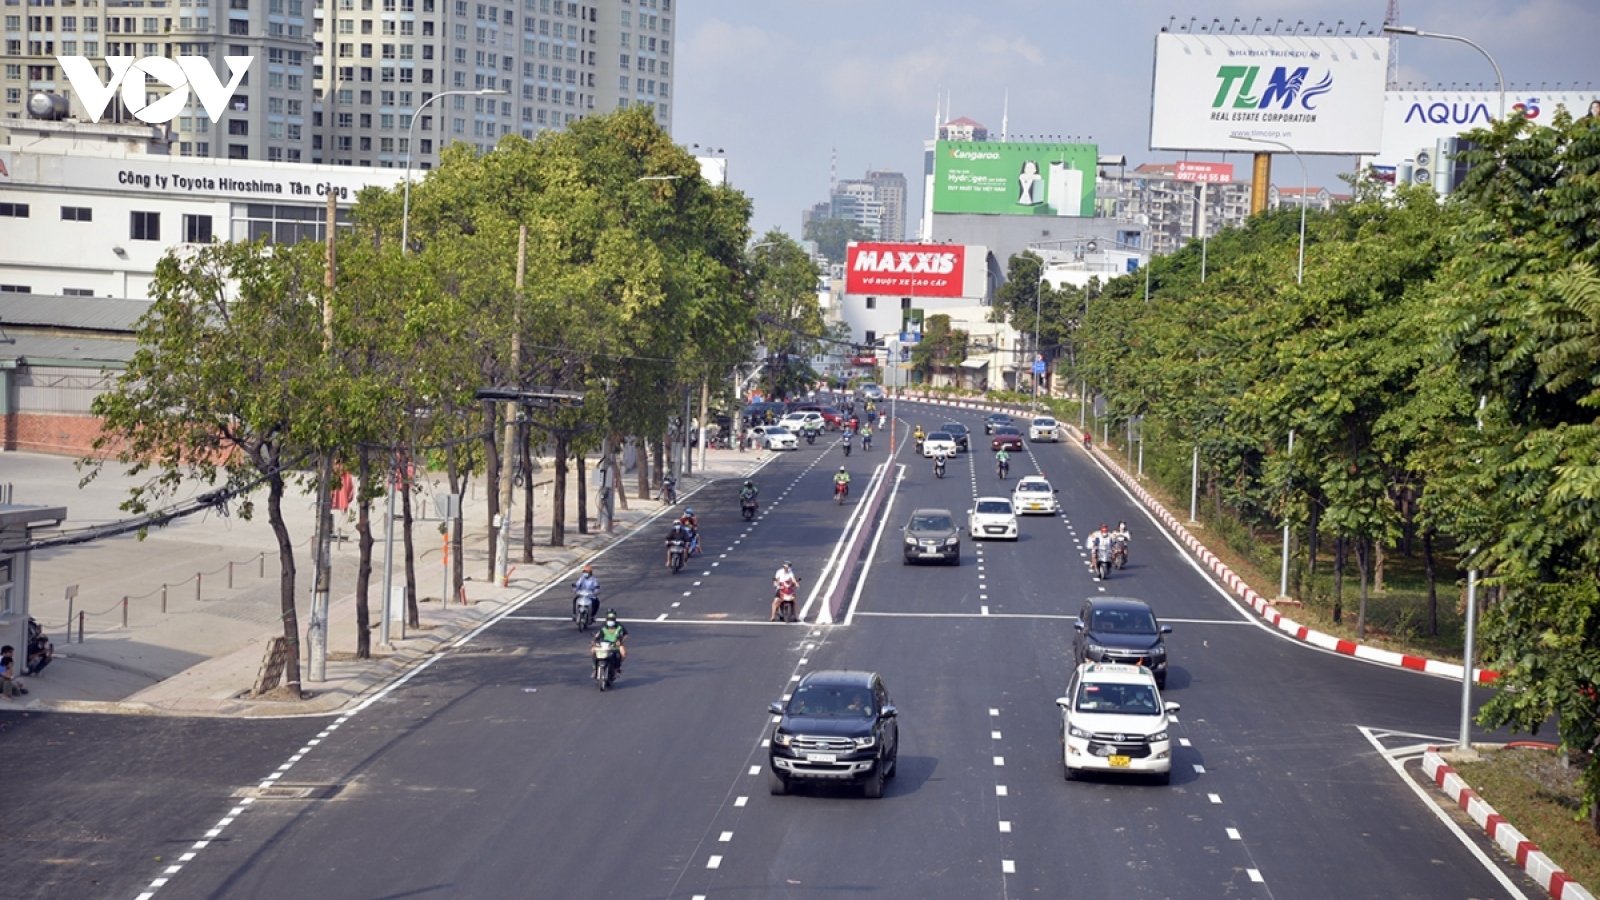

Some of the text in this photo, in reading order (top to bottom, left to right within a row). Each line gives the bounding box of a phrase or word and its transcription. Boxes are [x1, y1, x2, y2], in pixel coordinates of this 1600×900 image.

[1210, 112, 1317, 123] REAL ESTATE CORPORATION
[1404, 102, 1490, 124] AQUA
[118, 170, 348, 199] Công ty Toyota Hiroshima Tân Cảng
[853, 251, 954, 274] MAXXIS
